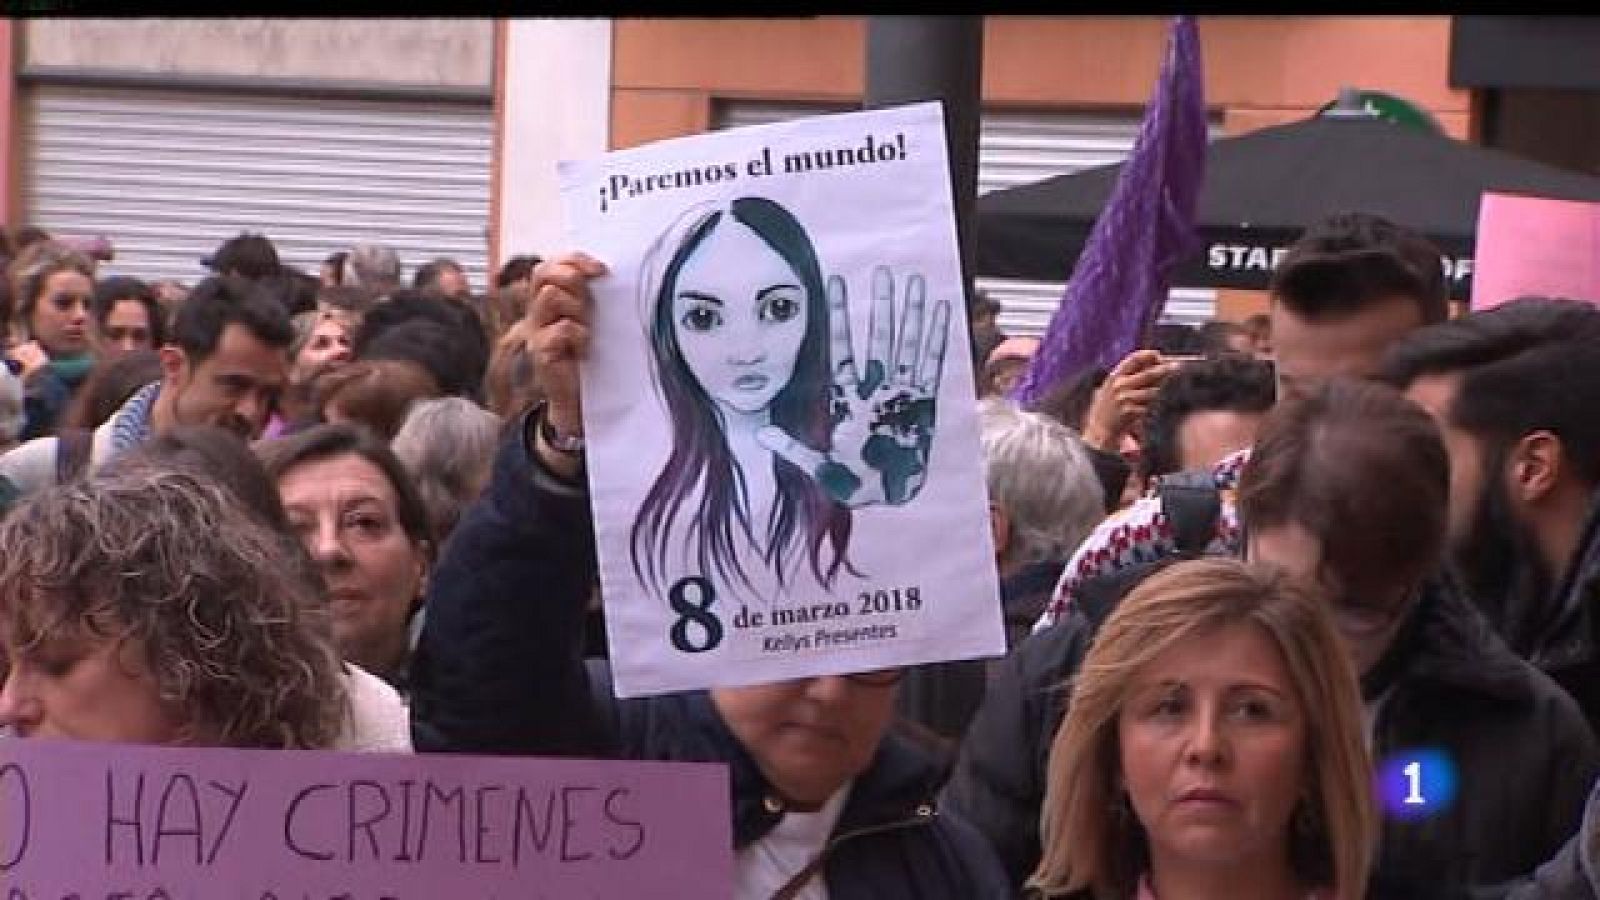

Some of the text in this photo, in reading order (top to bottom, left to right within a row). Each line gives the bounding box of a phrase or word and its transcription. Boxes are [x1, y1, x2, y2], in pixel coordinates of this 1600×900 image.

[599, 132, 906, 213] ¡Paremos el mundo!
[668, 575, 923, 653] 8 de marzo 2018
[814, 623, 898, 648] Presentes
[104, 769, 249, 867] HAY
[283, 778, 646, 864] CRIMENES
